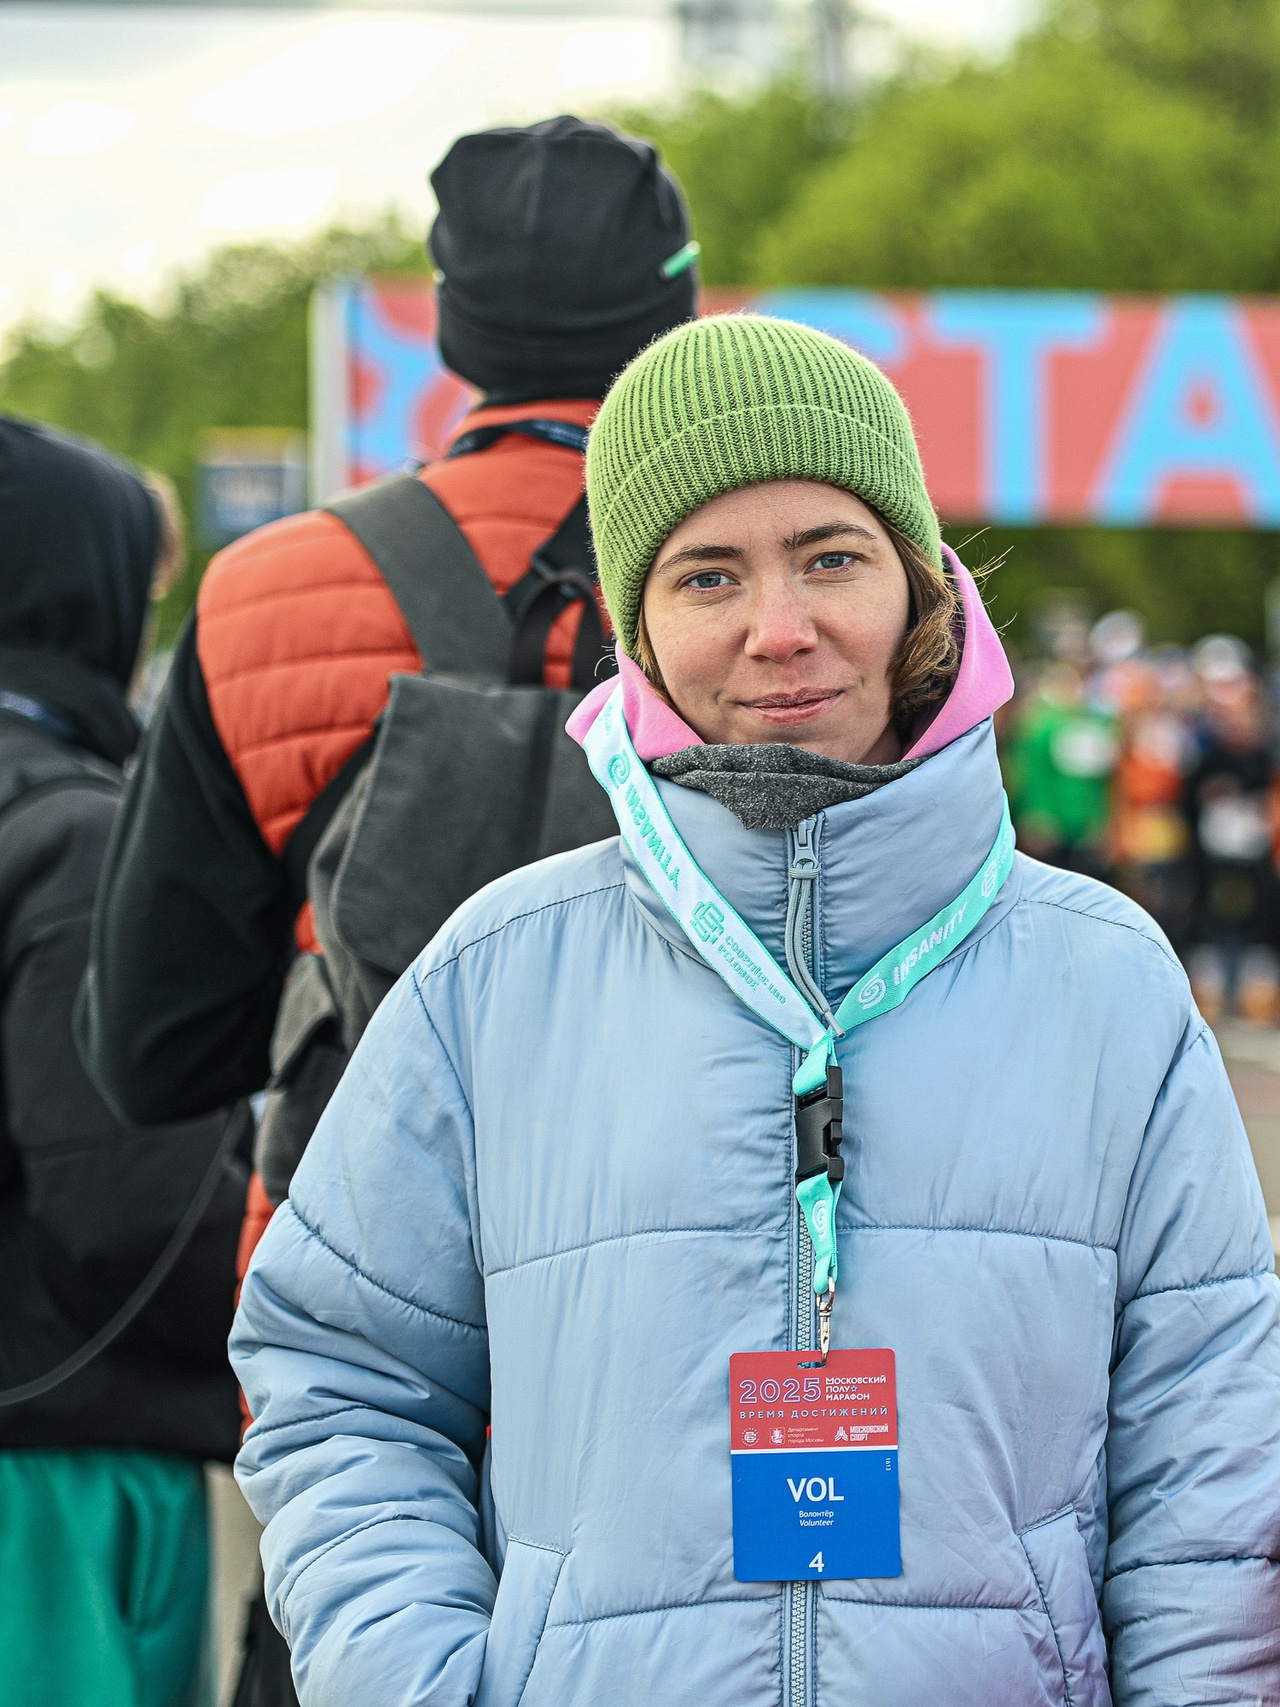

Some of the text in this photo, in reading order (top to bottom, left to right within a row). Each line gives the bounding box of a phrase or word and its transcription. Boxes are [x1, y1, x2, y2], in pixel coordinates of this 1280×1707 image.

[892, 901, 968, 986] INSANITY
[825, 1374, 887, 1385] МОСКОВСКИЙ
[739, 1377, 822, 1404] 2025
[825, 1393, 871, 1402] МАРАФОН
[739, 1405, 888, 1419] ВРЕМЯ ДОСТИЖЕНИЙ
[850, 1423, 889, 1433] МОСКОВСКИЙ
[850, 1433, 869, 1442] СПОРТ
[786, 1476, 845, 1503] VOL
[798, 1510, 835, 1518] Волонтёр
[799, 1519, 835, 1527] Volunteer
[808, 1551, 825, 1573] 4
